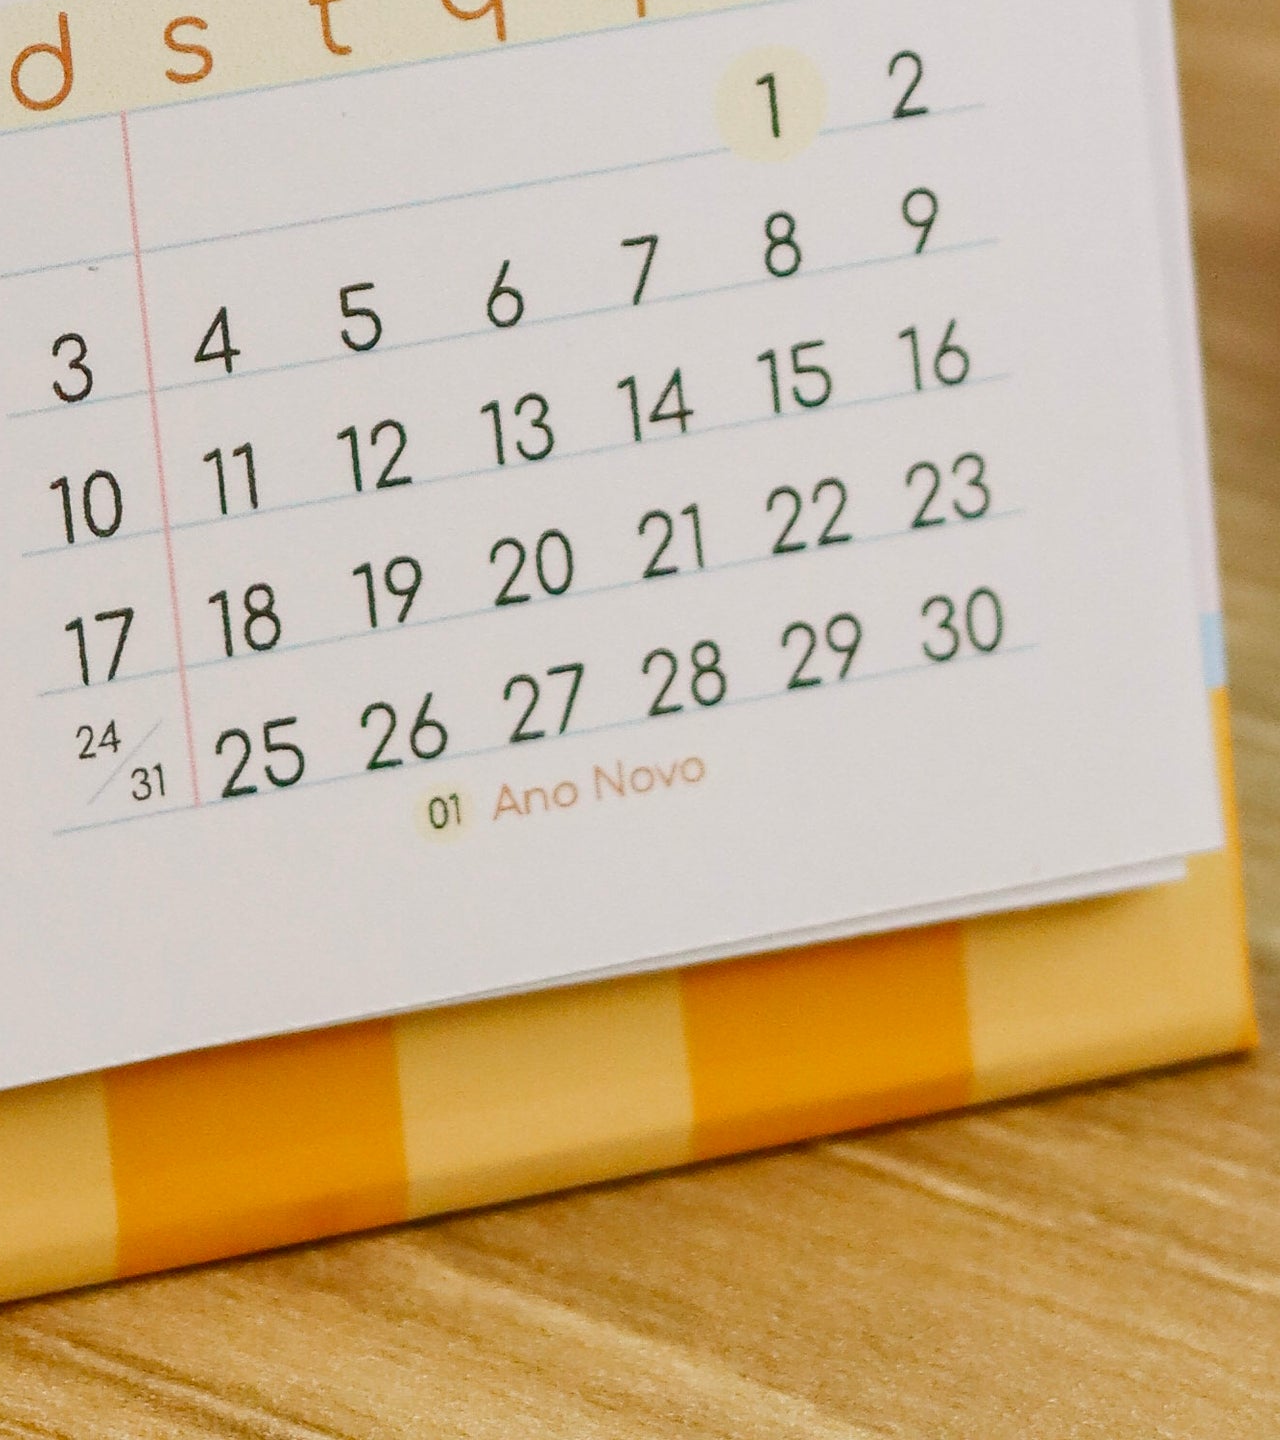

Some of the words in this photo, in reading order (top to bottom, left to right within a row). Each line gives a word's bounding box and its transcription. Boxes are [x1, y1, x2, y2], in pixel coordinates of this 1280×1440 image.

[11, 12, 73, 111] d
[164, 16, 212, 84] s
[757, 74, 780, 138] 1
[889, 51, 928, 119] 2
[52, 333, 93, 403] 3
[194, 307, 240, 373] 4
[340, 283, 382, 352] 5
[487, 260, 524, 328] 6
[621, 235, 658, 305] 7
[765, 212, 801, 278] 8
[902, 188, 938, 254] 9
[50, 470, 122, 544] 10
[203, 443, 258, 515] 11
[338, 420, 412, 492] 12
[481, 393, 554, 466] 13
[618, 369, 693, 442] 14
[758, 341, 832, 414] 15
[899, 320, 970, 391] 16
[65, 608, 134, 686] 17
[209, 584, 281, 657] 18
[353, 557, 422, 628] 19
[490, 529, 573, 607] 20
[638, 504, 704, 580] 21
[767, 478, 852, 555] 22
[906, 453, 990, 530] 23
[76, 720, 121, 759] 24
[131, 764, 165, 801] 31
[216, 717, 305, 799] 25
[361, 693, 448, 771] 26
[504, 663, 584, 744] 27
[642, 640, 726, 717] 28
[782, 613, 862, 690] 29
[922, 587, 1003, 663] 30
[428, 793, 461, 830] 01
[493, 781, 578, 820] Ano
[593, 757, 706, 799] Novo
